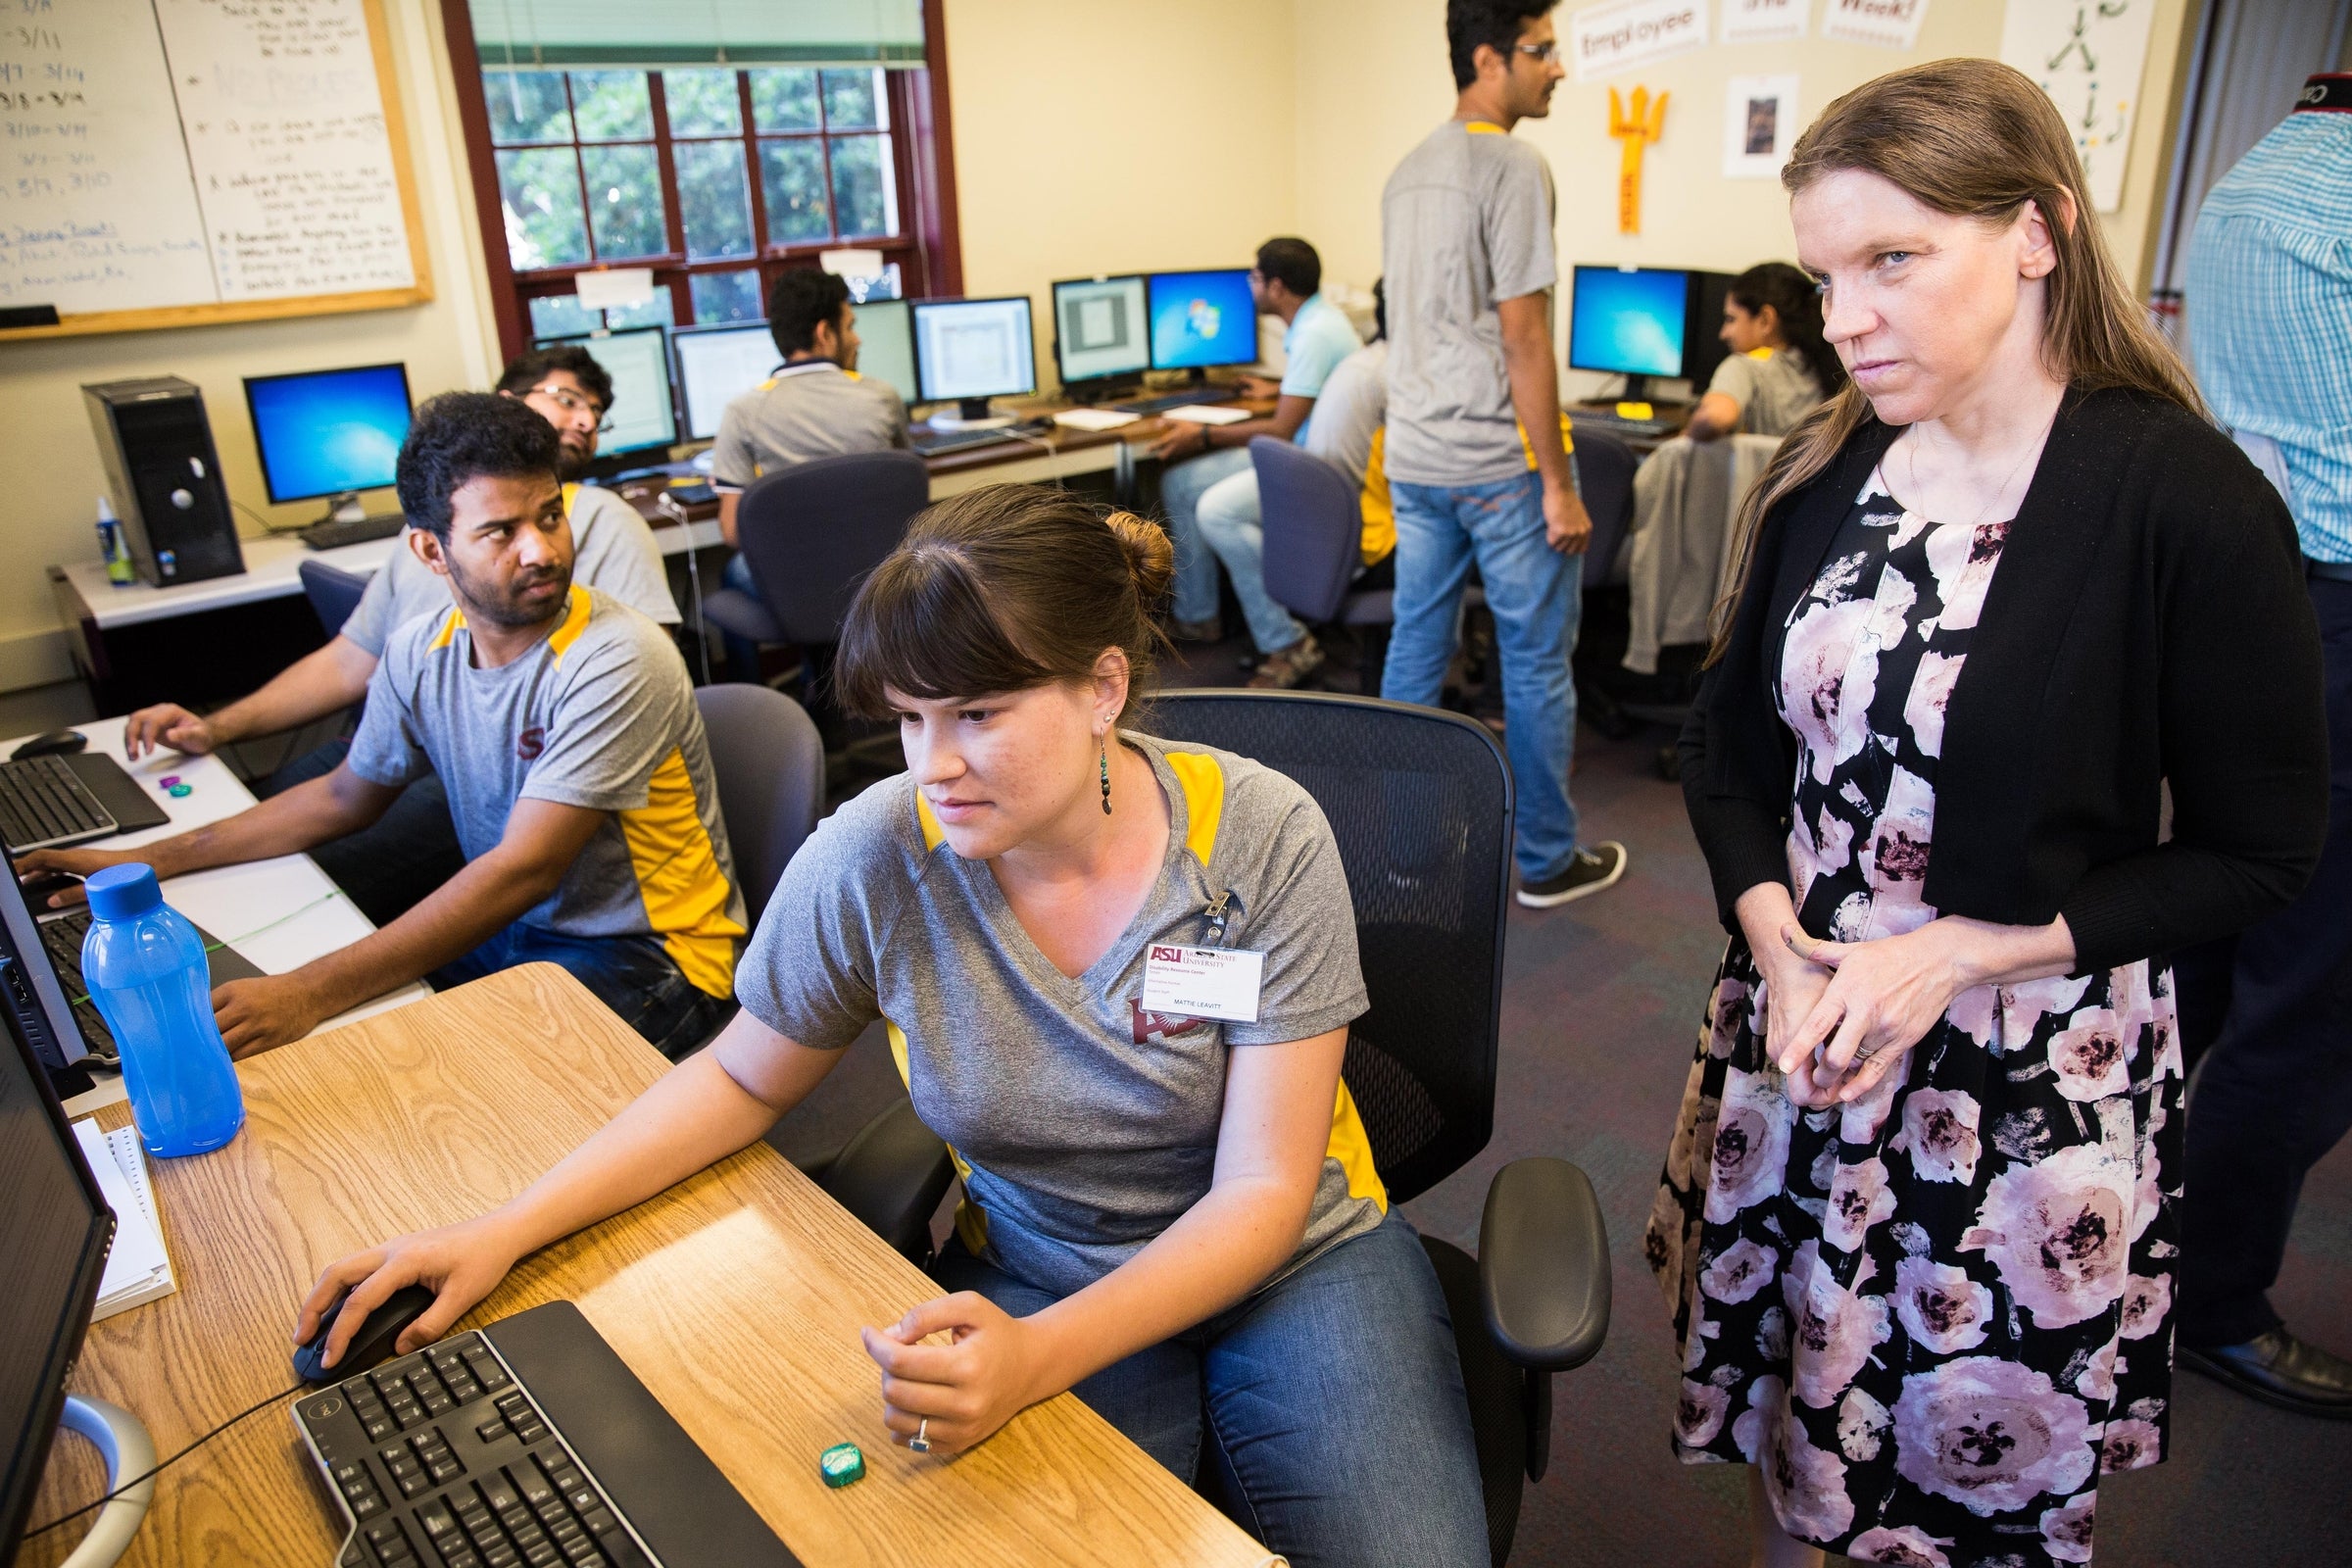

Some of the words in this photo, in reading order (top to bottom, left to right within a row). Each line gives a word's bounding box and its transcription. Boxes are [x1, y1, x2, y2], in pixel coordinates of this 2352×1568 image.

[1581, 9, 1694, 57] Employee
[1150, 947, 1182, 963] ASU
[1216, 954, 1236, 962] STATE
[1183, 957, 1224, 968] UNIVERSITY
[1174, 999, 1196, 1007] MATTIE
